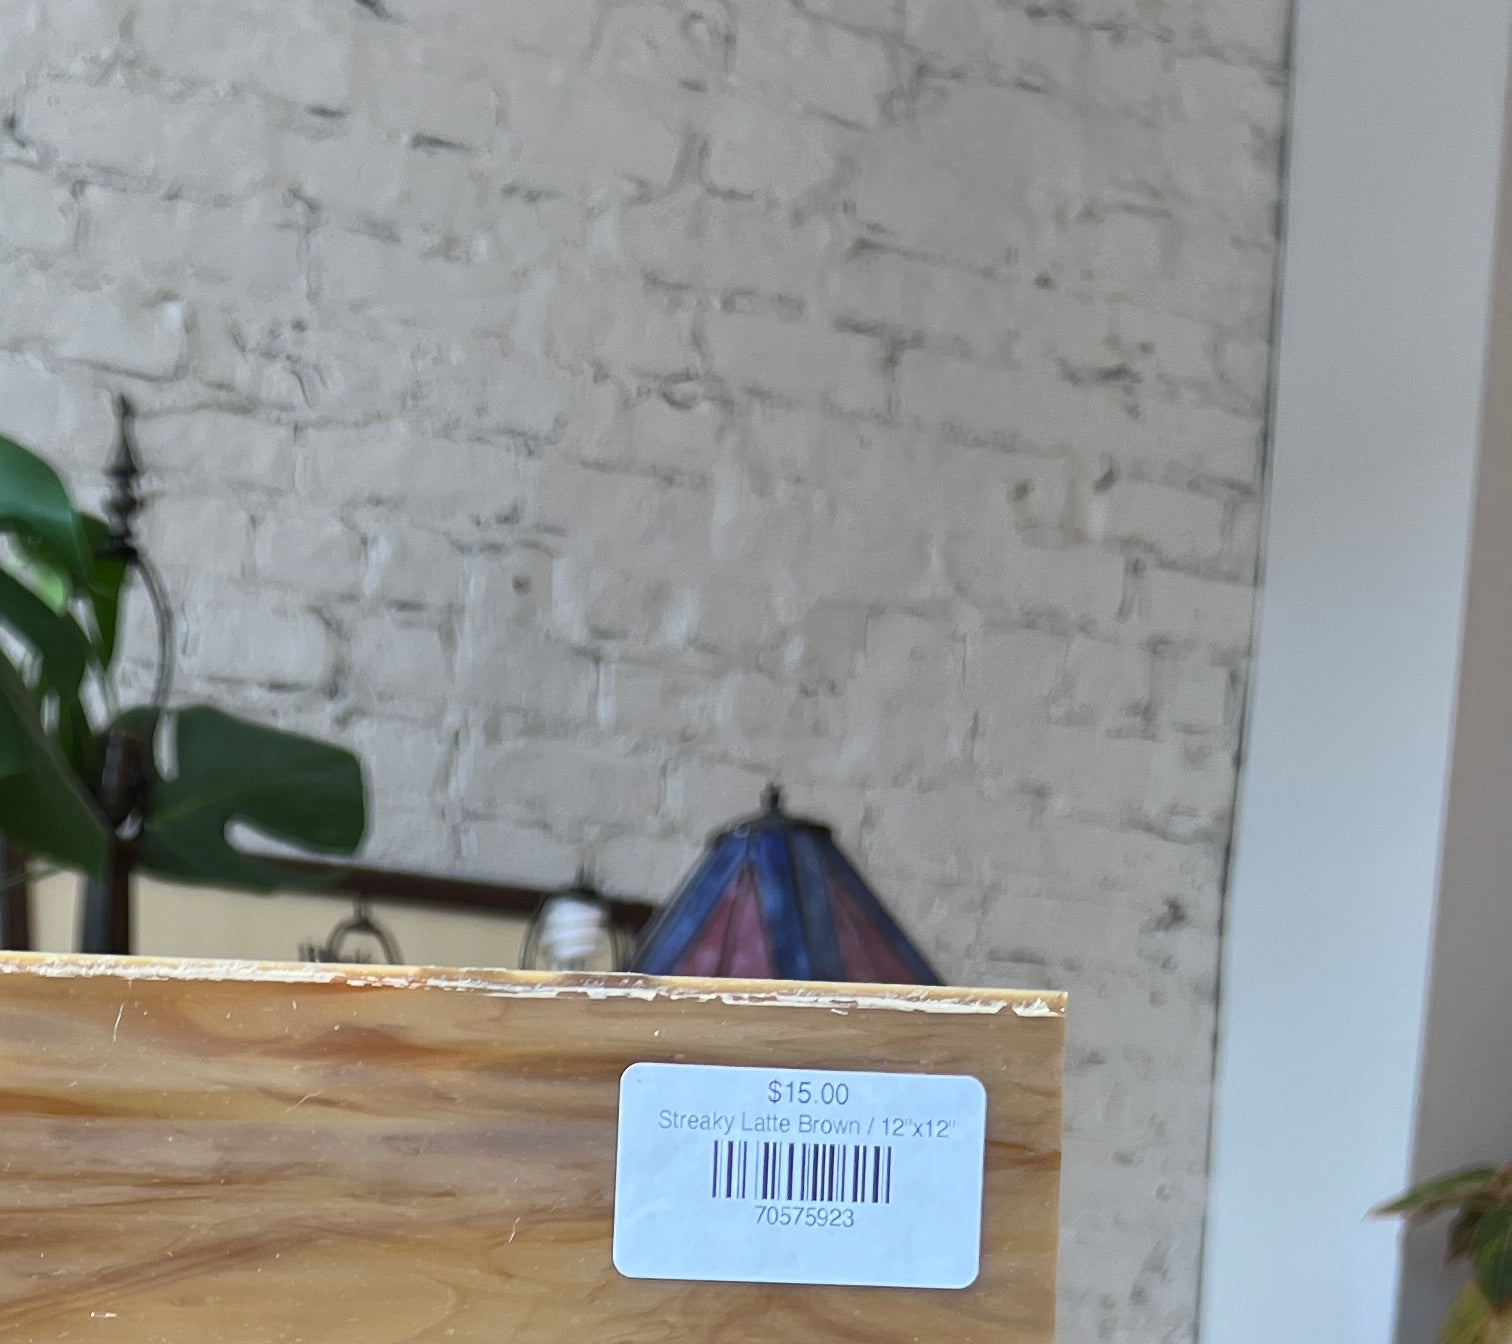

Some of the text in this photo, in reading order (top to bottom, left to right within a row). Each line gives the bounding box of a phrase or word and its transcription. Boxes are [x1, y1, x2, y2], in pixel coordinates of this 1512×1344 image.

[768, 1079, 849, 1105] $15.00
[658, 1109, 735, 1135] Streaky
[741, 1112, 790, 1133] Latte
[798, 1115, 861, 1135] Brown
[882, 1118, 956, 1139] 12"x12"
[754, 1205, 855, 1228] 70575923
